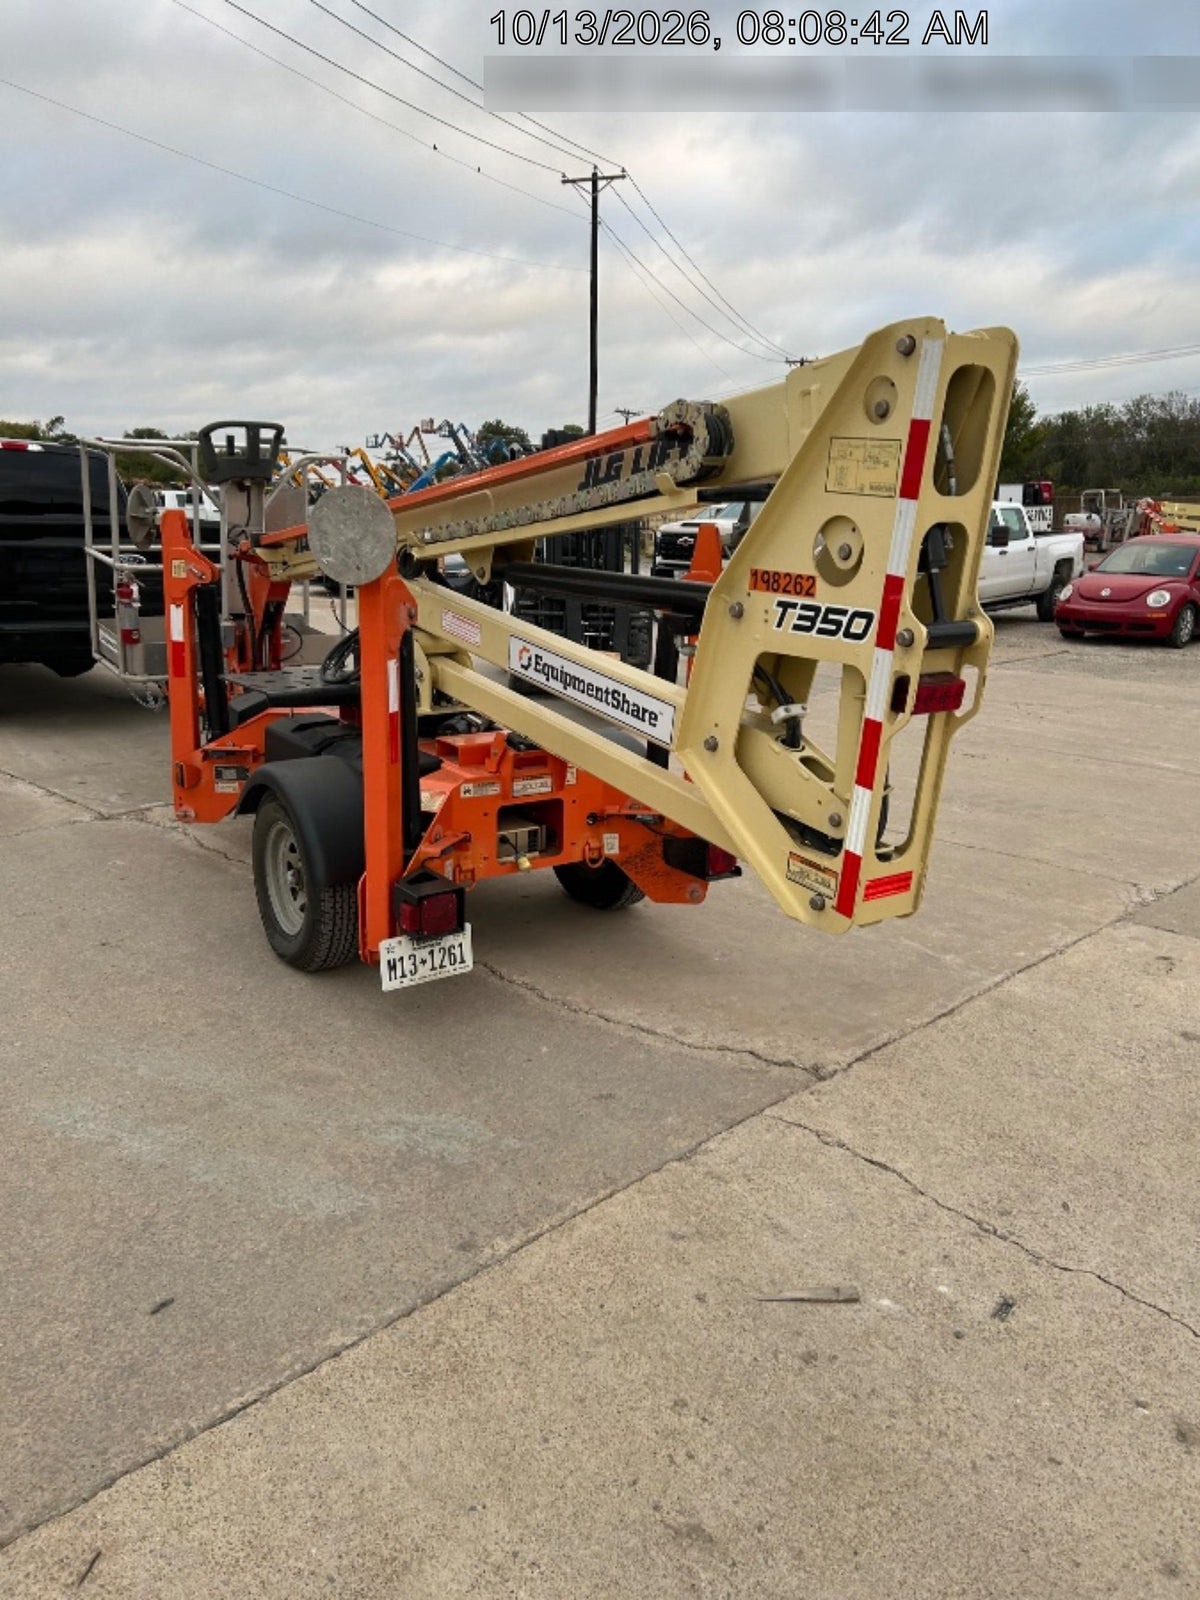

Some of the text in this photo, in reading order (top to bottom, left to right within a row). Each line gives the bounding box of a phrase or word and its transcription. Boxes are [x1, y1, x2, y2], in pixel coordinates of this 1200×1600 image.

[750, 568, 817, 598] 198262
[774, 599, 876, 642] T350
[533, 653, 660, 728] EquipmentShare
